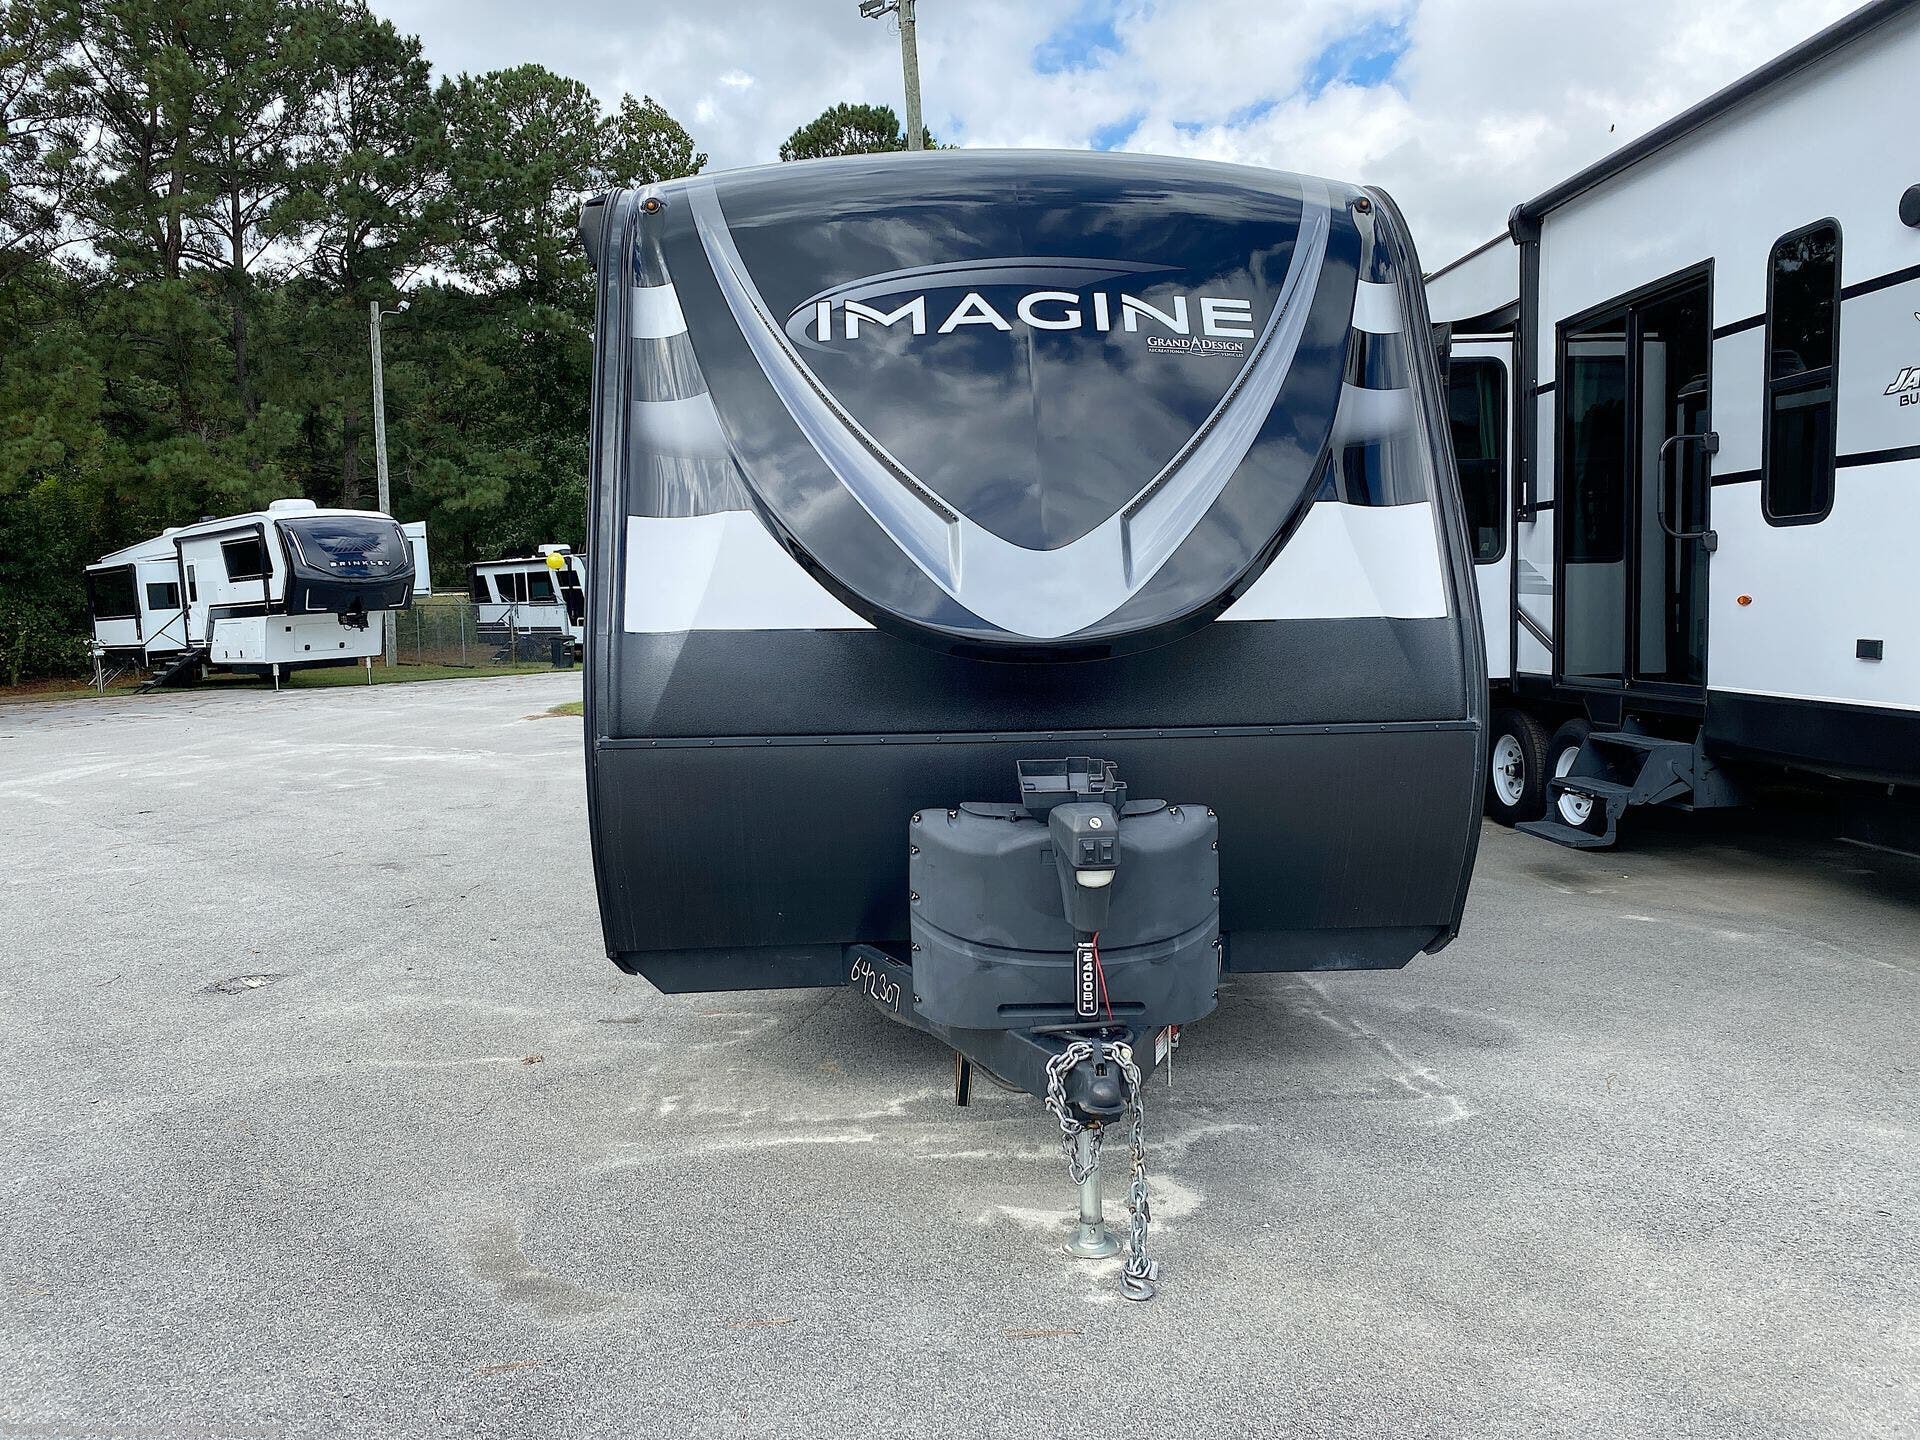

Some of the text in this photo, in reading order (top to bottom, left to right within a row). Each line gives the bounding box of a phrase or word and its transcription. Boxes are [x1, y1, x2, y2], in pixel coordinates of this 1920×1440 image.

[816, 291, 1255, 341] IMAGINE
[1883, 367, 1920, 395] JA
[1900, 392, 1920, 406] BU
[330, 560, 390, 568] BRINKLEY
[851, 956, 900, 1012] 642307
[1082, 952, 1093, 1011] 2400BH
